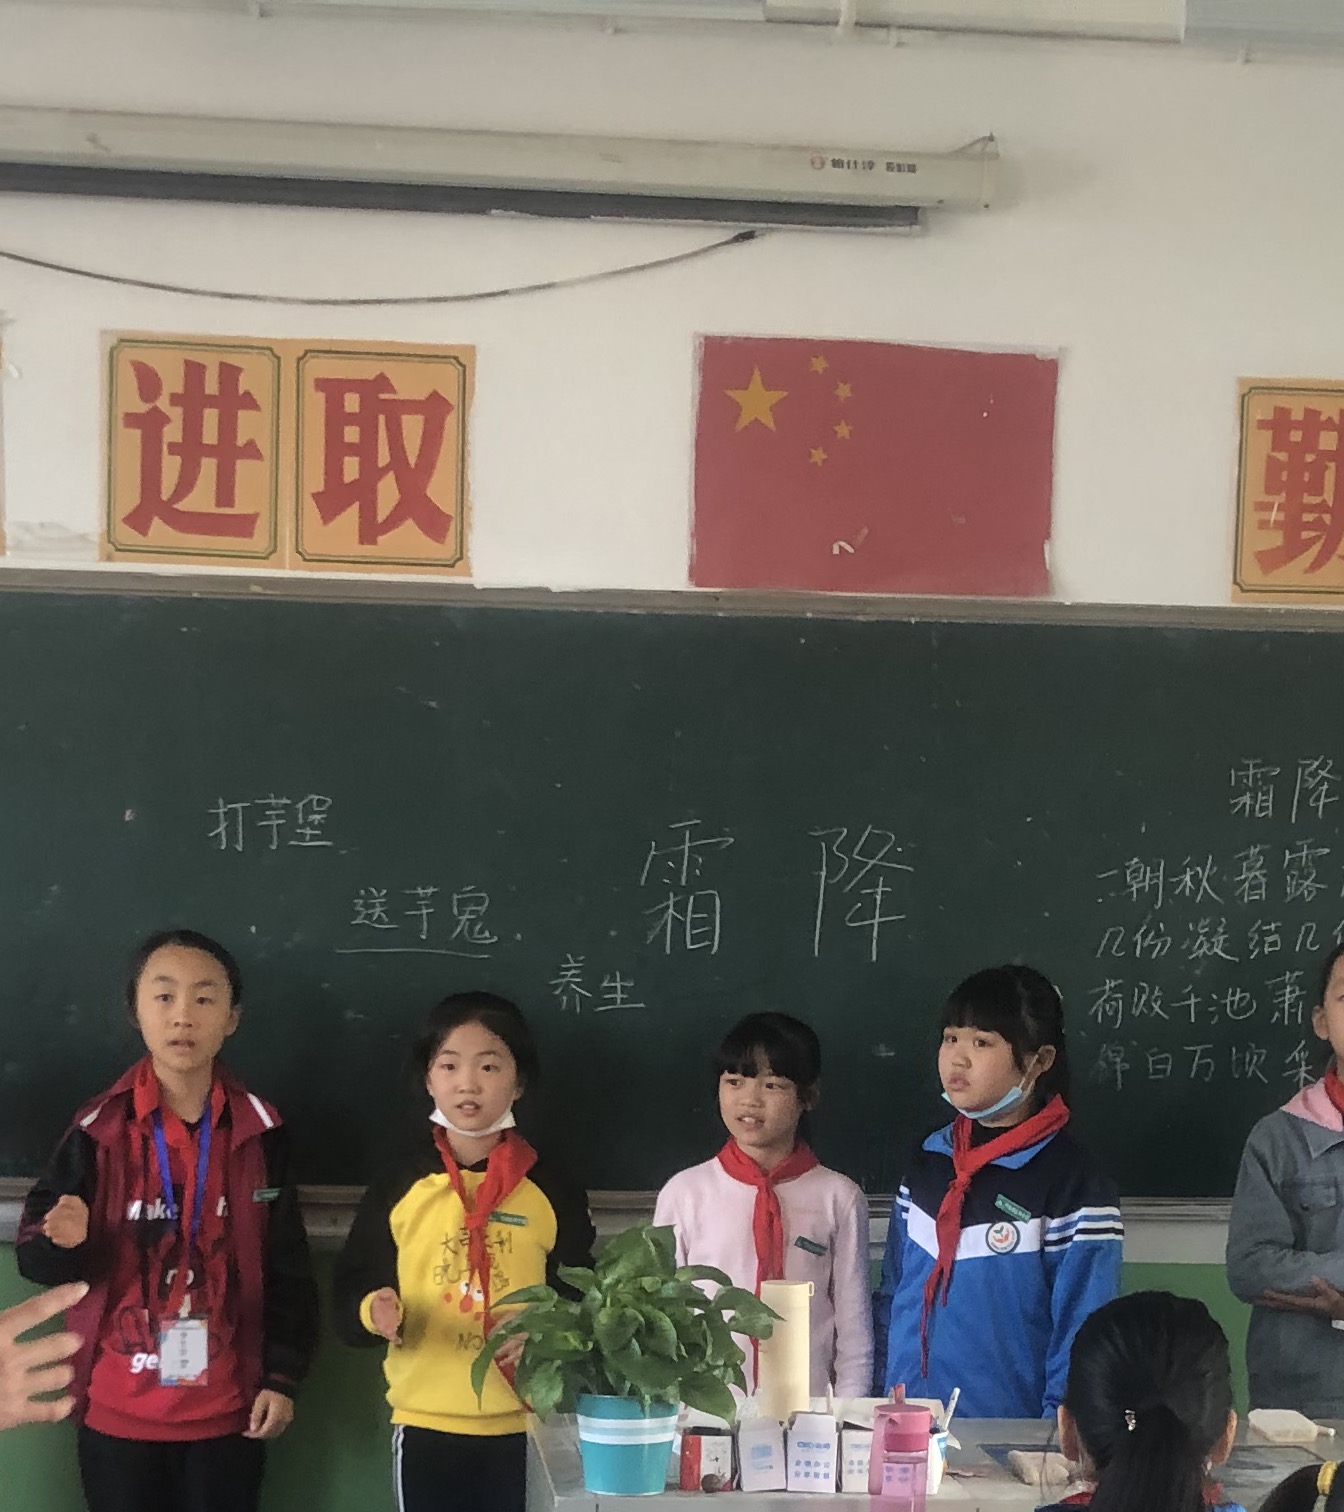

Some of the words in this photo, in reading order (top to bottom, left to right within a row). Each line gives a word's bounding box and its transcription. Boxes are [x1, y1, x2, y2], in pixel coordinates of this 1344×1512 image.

[122, 357, 455, 546] 进取
[1229, 754, 1342, 824] 霜降
[639, 818, 917, 962] 霜降
[548, 955, 647, 1012] 养生
